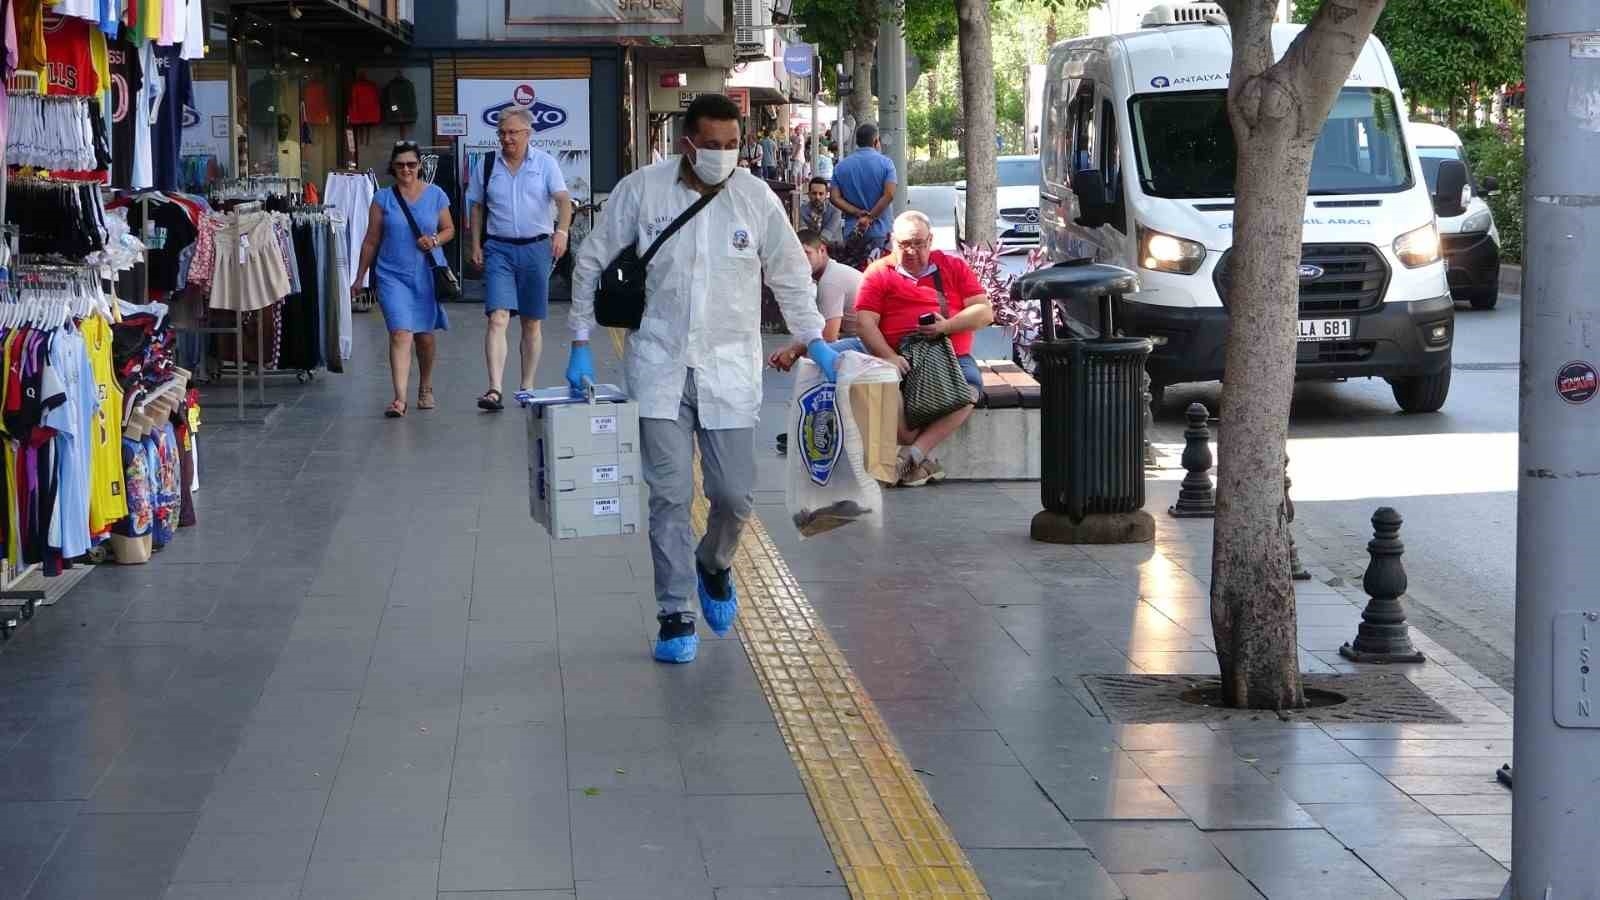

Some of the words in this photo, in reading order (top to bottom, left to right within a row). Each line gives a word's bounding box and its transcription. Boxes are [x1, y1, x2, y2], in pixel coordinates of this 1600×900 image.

[108, 50, 126, 64] SSI
[47, 62, 78, 90] LLS
[1173, 74, 1224, 87] ANTALYA
[486, 110, 563, 124] CYO
[531, 138, 573, 147] OOTWEAR
[1297, 321, 1316, 336] LA
[1324, 320, 1347, 335] 681
